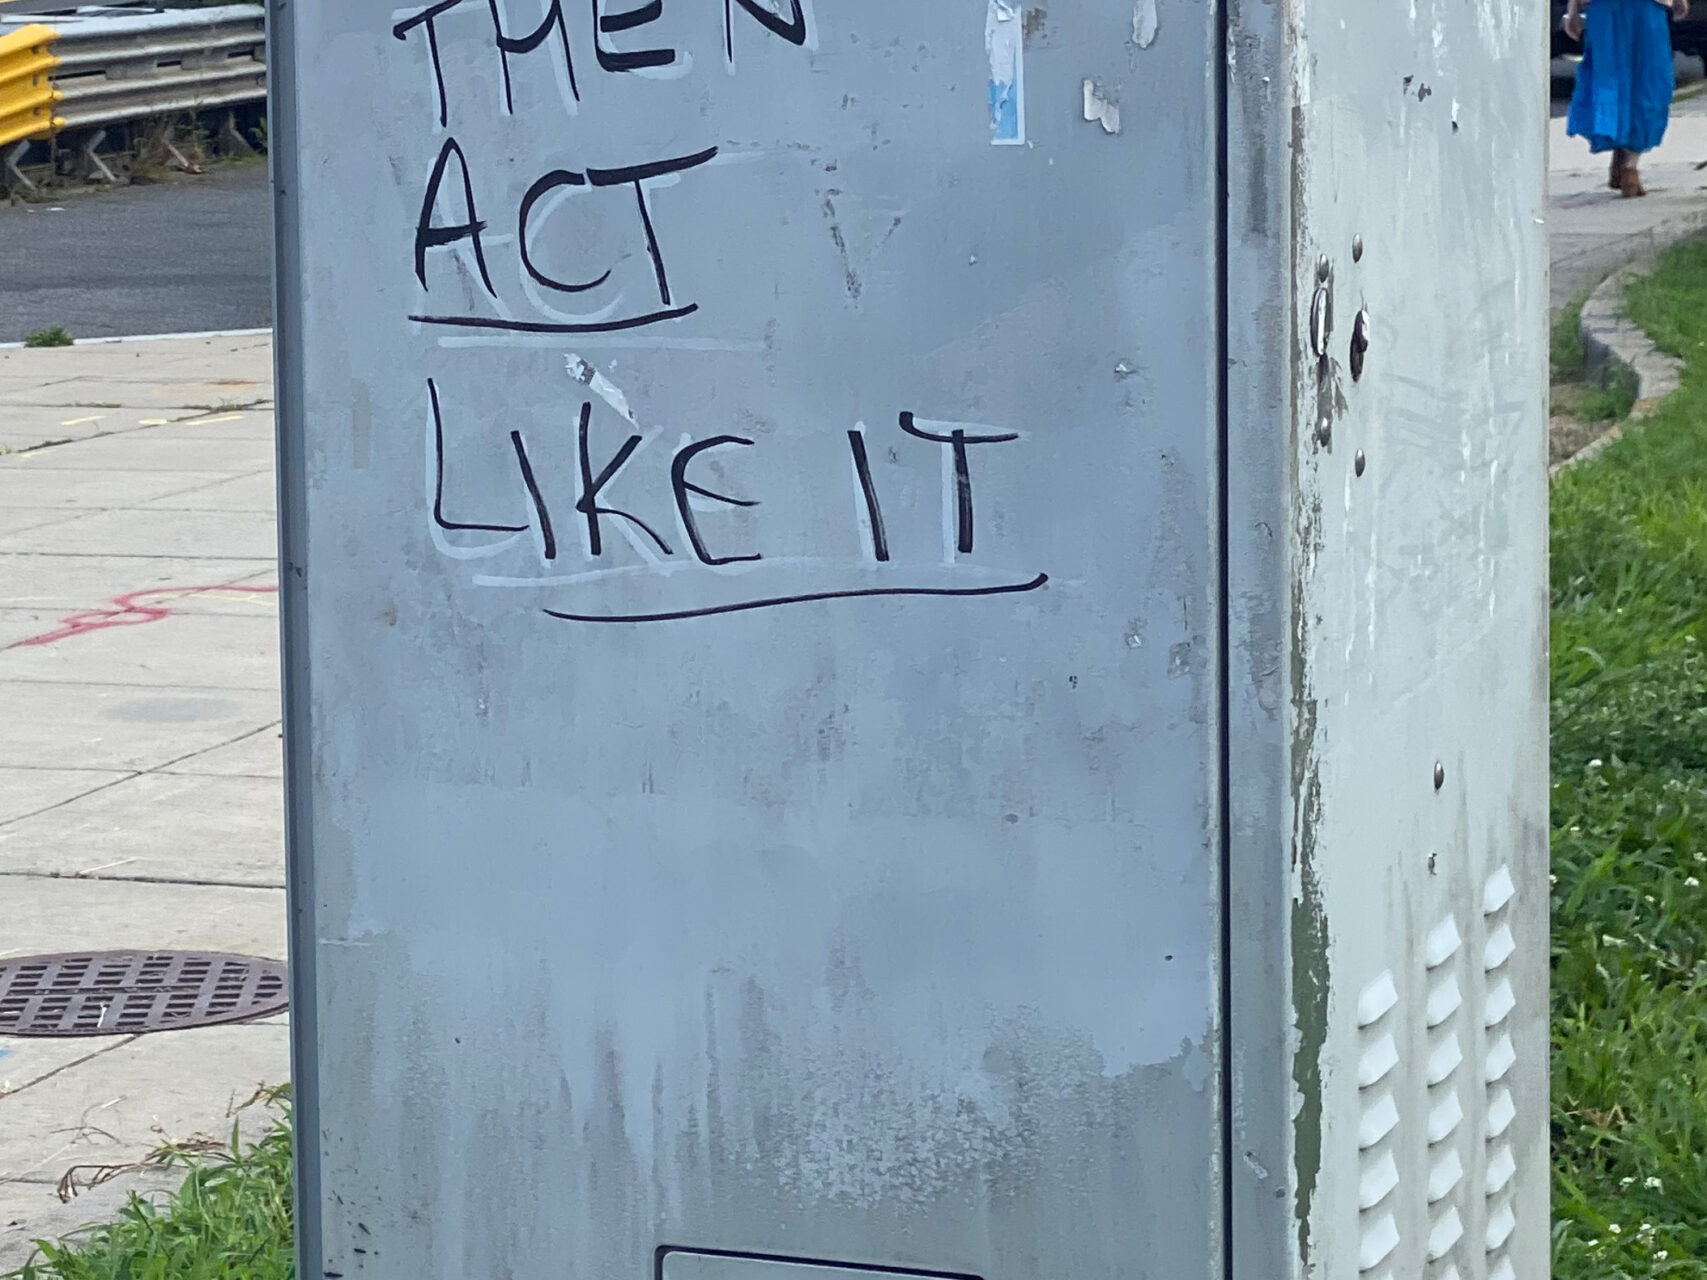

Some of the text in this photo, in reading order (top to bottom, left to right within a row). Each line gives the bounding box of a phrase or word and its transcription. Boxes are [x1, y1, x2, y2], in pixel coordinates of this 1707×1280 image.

[414, 137, 719, 308] ACT
[426, 378, 1021, 566] LIKE IT
